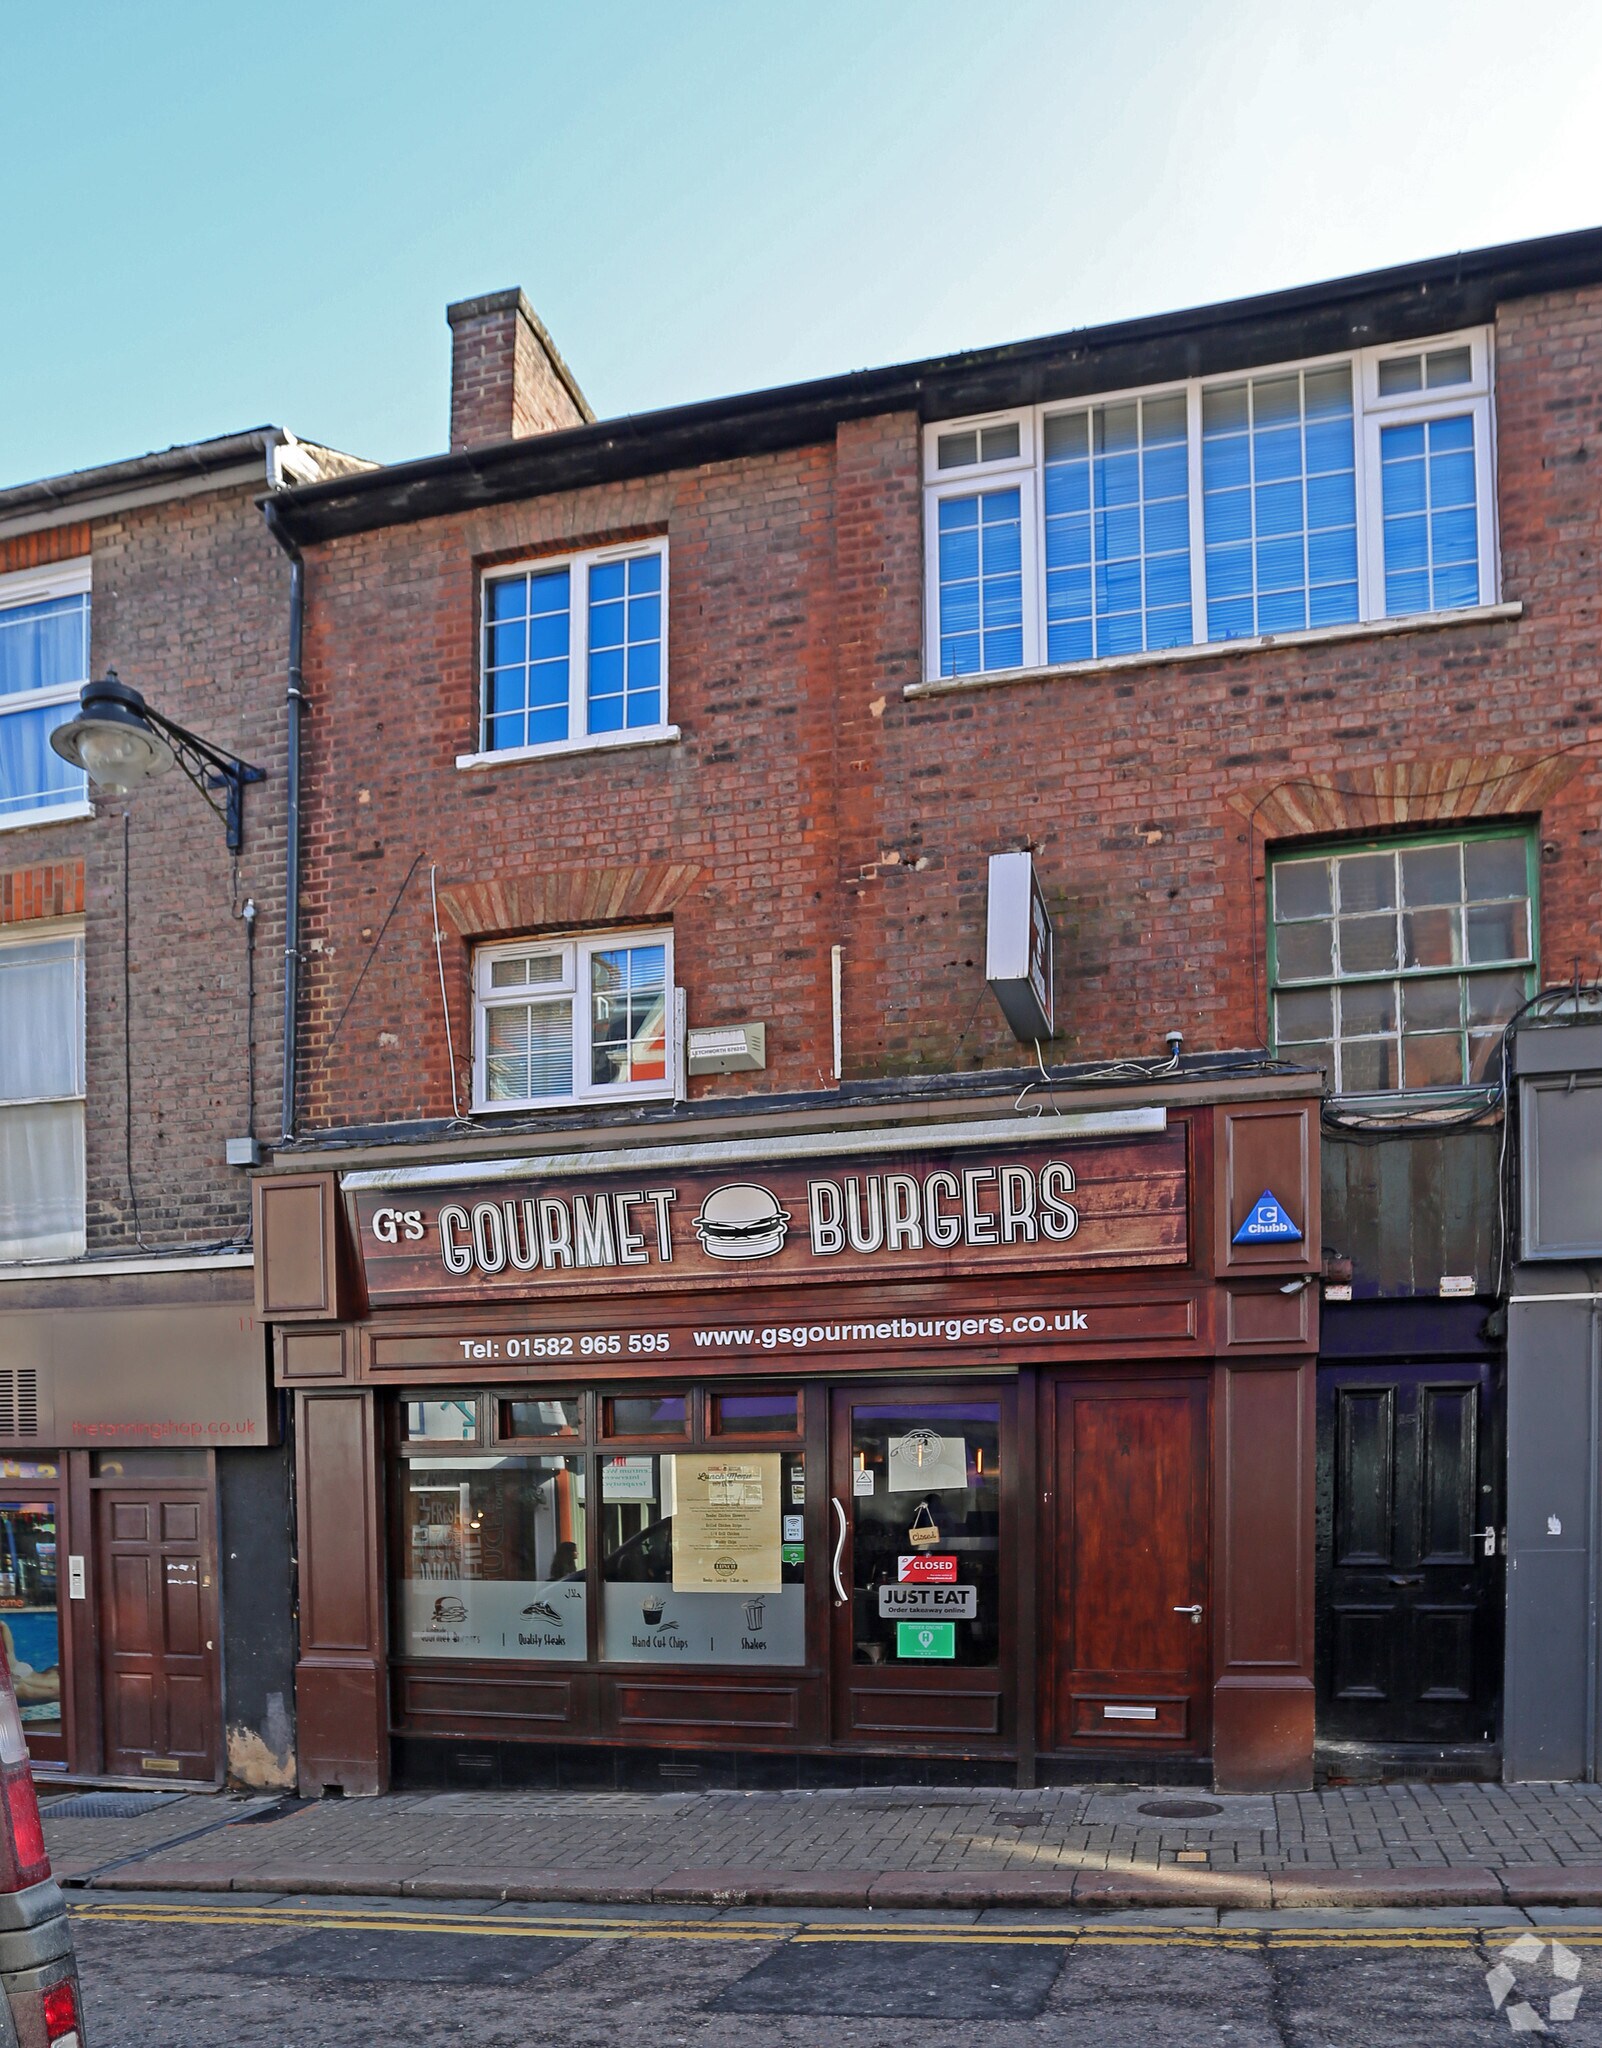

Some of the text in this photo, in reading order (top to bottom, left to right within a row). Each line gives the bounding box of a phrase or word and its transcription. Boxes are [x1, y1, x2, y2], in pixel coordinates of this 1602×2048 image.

[438, 1188, 677, 1275] GOURMET
[806, 1161, 1079, 1256] BURGERS
[1248, 1222, 1288, 1234] Chubb
[459, 1310, 1089, 1359] Tel: 01582 965 595 www.gsgourmetburgers.co.uk
[72, 1418, 256, 1440] thetanningshop.co.uk
[913, 1561, 953, 1570] CLOSED
[884, 1590, 970, 1604] JUST EAT
[909, 1607, 943, 1615] takeaway
[518, 1632, 566, 1647] Quality Steaks
[631, 1635, 689, 1651] Hand Cut Chips
[741, 1637, 767, 1650] Shakes
